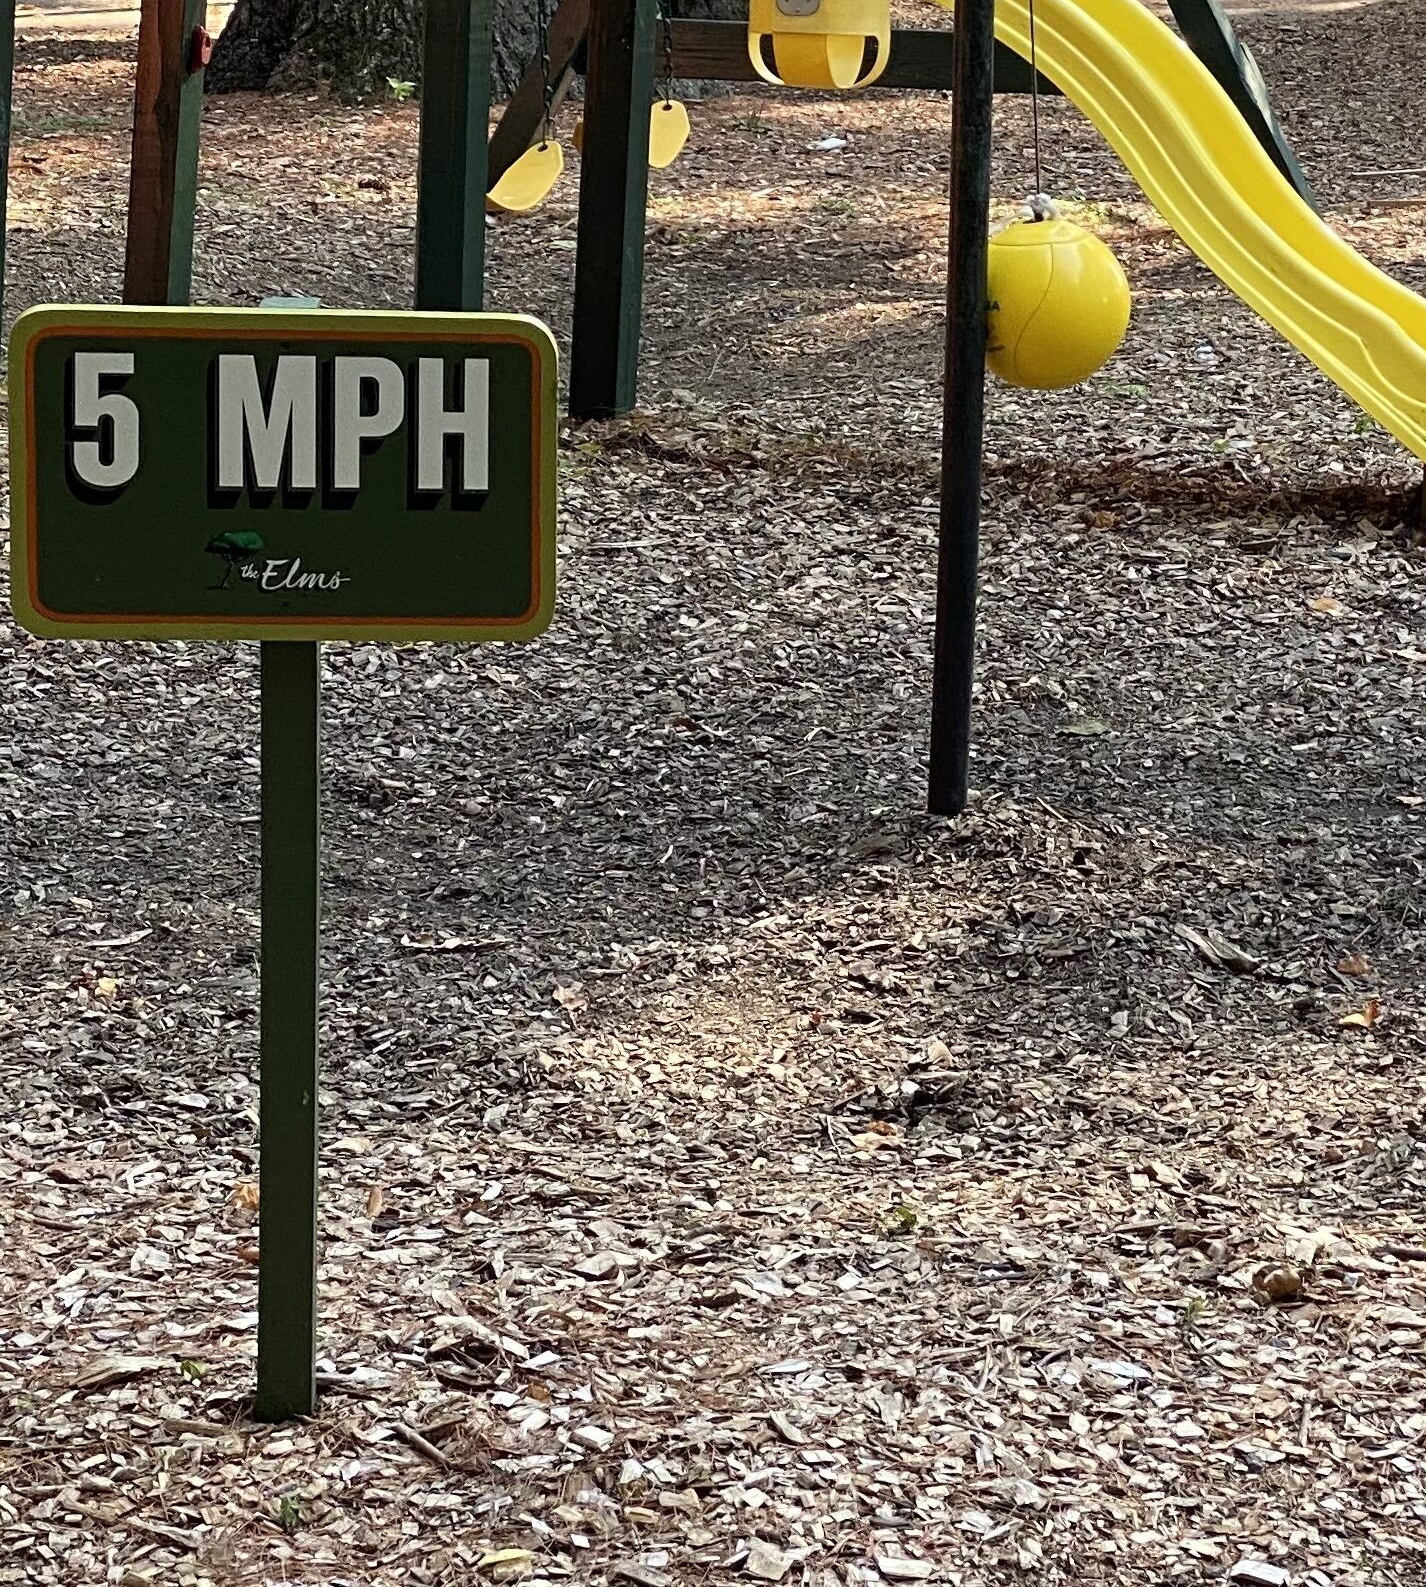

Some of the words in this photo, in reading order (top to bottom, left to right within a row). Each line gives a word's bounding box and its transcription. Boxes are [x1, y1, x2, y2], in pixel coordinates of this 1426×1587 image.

[70, 351, 140, 488] 5
[216, 353, 490, 491] MPH
[240, 563, 260, 579] the
[261, 557, 351, 590] Elms
